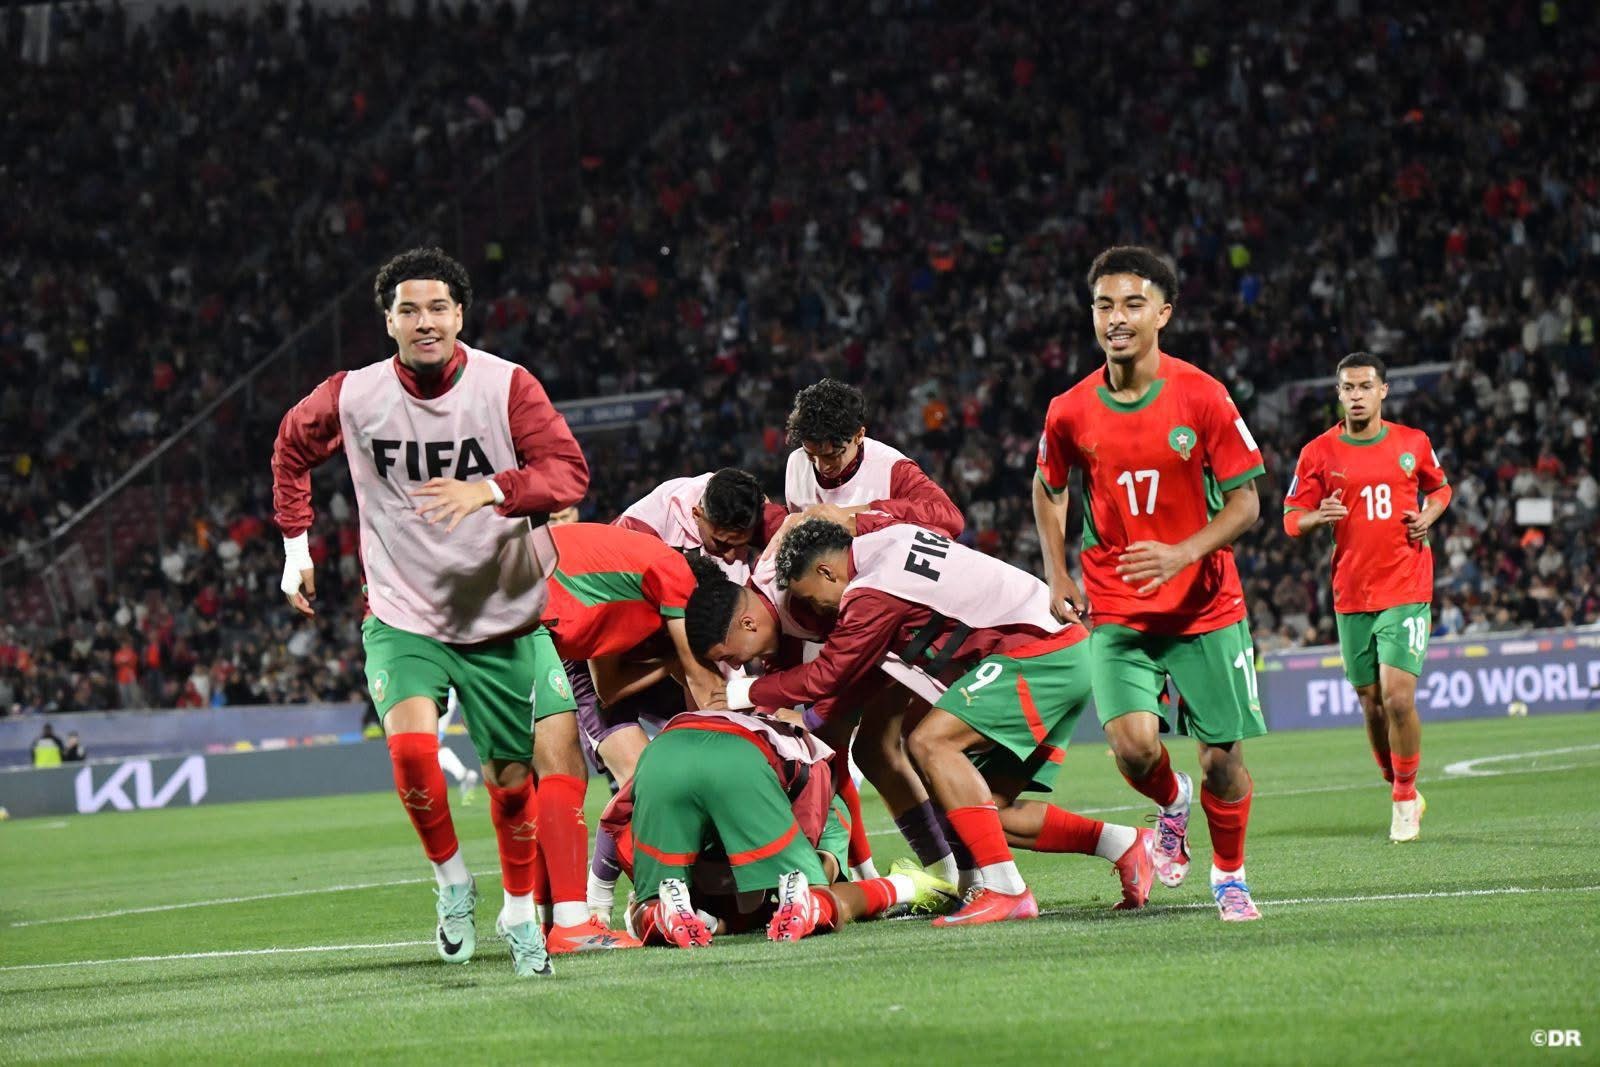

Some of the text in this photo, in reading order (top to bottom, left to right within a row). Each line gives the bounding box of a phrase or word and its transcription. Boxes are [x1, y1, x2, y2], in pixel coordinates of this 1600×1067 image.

[372, 437, 495, 481] FIFA
[1117, 469, 1159, 516] 17
[1360, 483, 1392, 521] 18
[1402, 616, 1425, 651] 18
[967, 662, 1003, 692] 9
[1308, 678, 1363, 716] FIF
[75, 755, 207, 814] KIA
